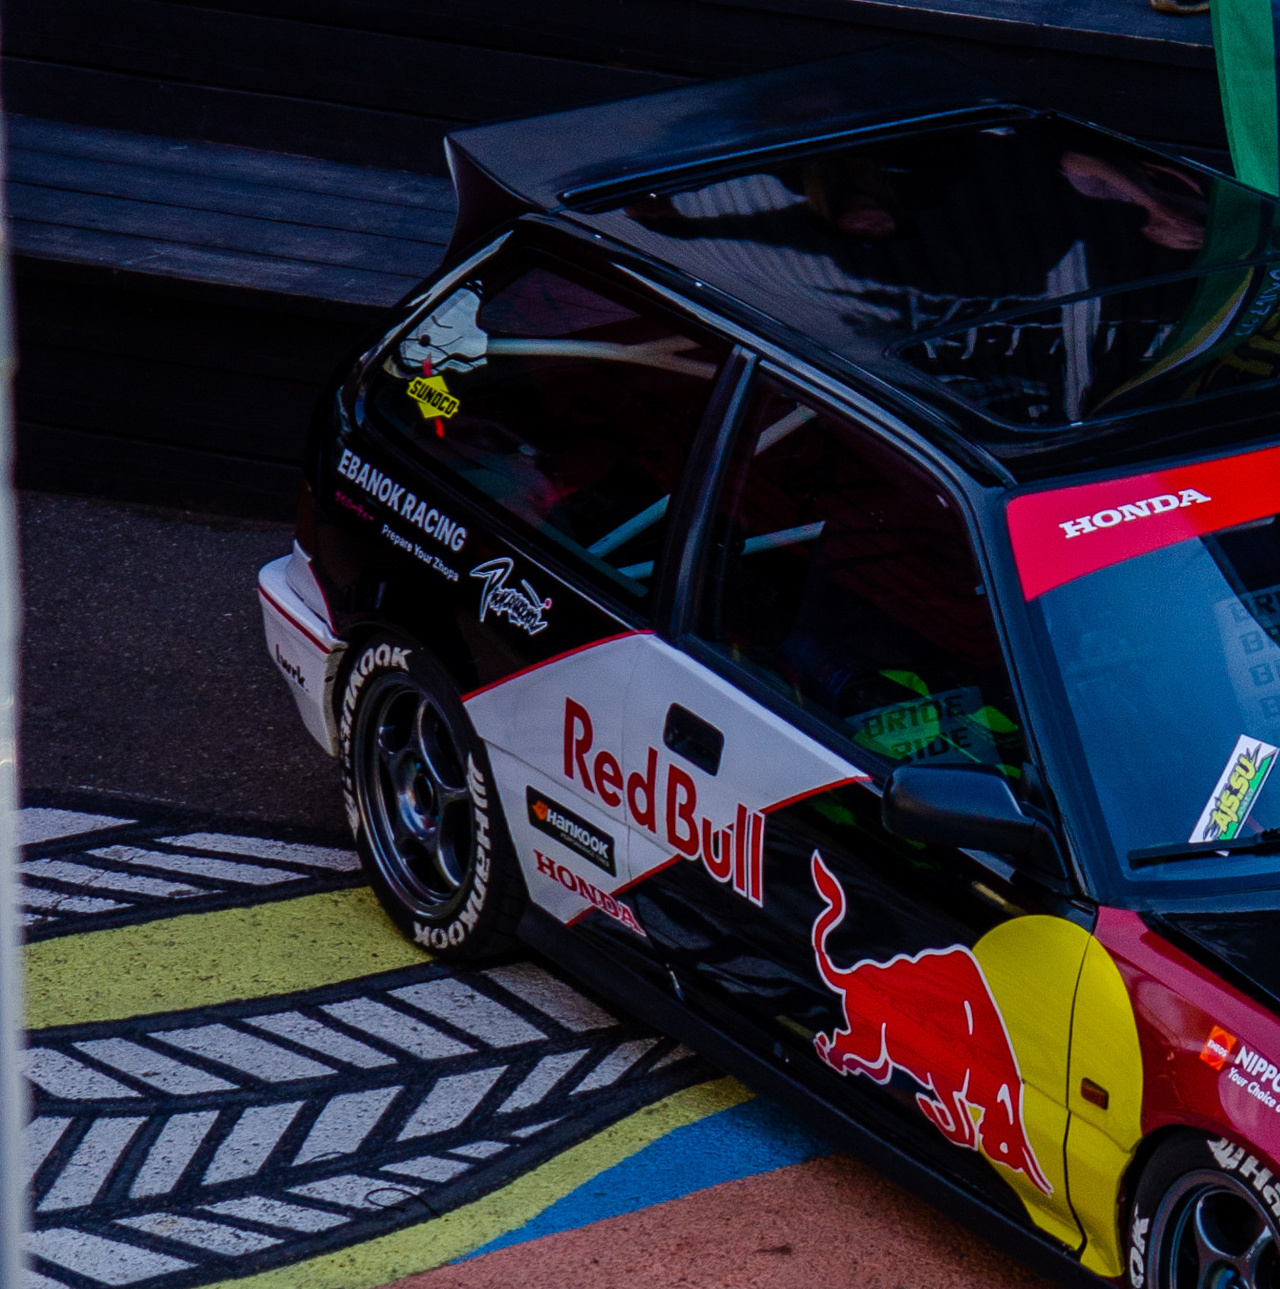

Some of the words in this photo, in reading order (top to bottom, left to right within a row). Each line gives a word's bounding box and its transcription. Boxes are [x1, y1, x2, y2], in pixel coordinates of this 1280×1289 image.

[410, 378, 456, 415] SUNOCO
[337, 448, 406, 513] EBANOK
[399, 492, 468, 553] RACING
[1059, 486, 1211, 540] HONDA
[380, 523, 413, 553] Prepare
[413, 544, 433, 565] Your
[431, 557, 460, 583] Zhopa
[564, 697, 657, 833] Red
[666, 761, 765, 908] Bull
[533, 849, 647, 938] HONDA
[1206, 1039, 1229, 1058] ENEOS
[1227, 1066, 1249, 1088] Your
[1247, 1081, 1277, 1108] Choice
